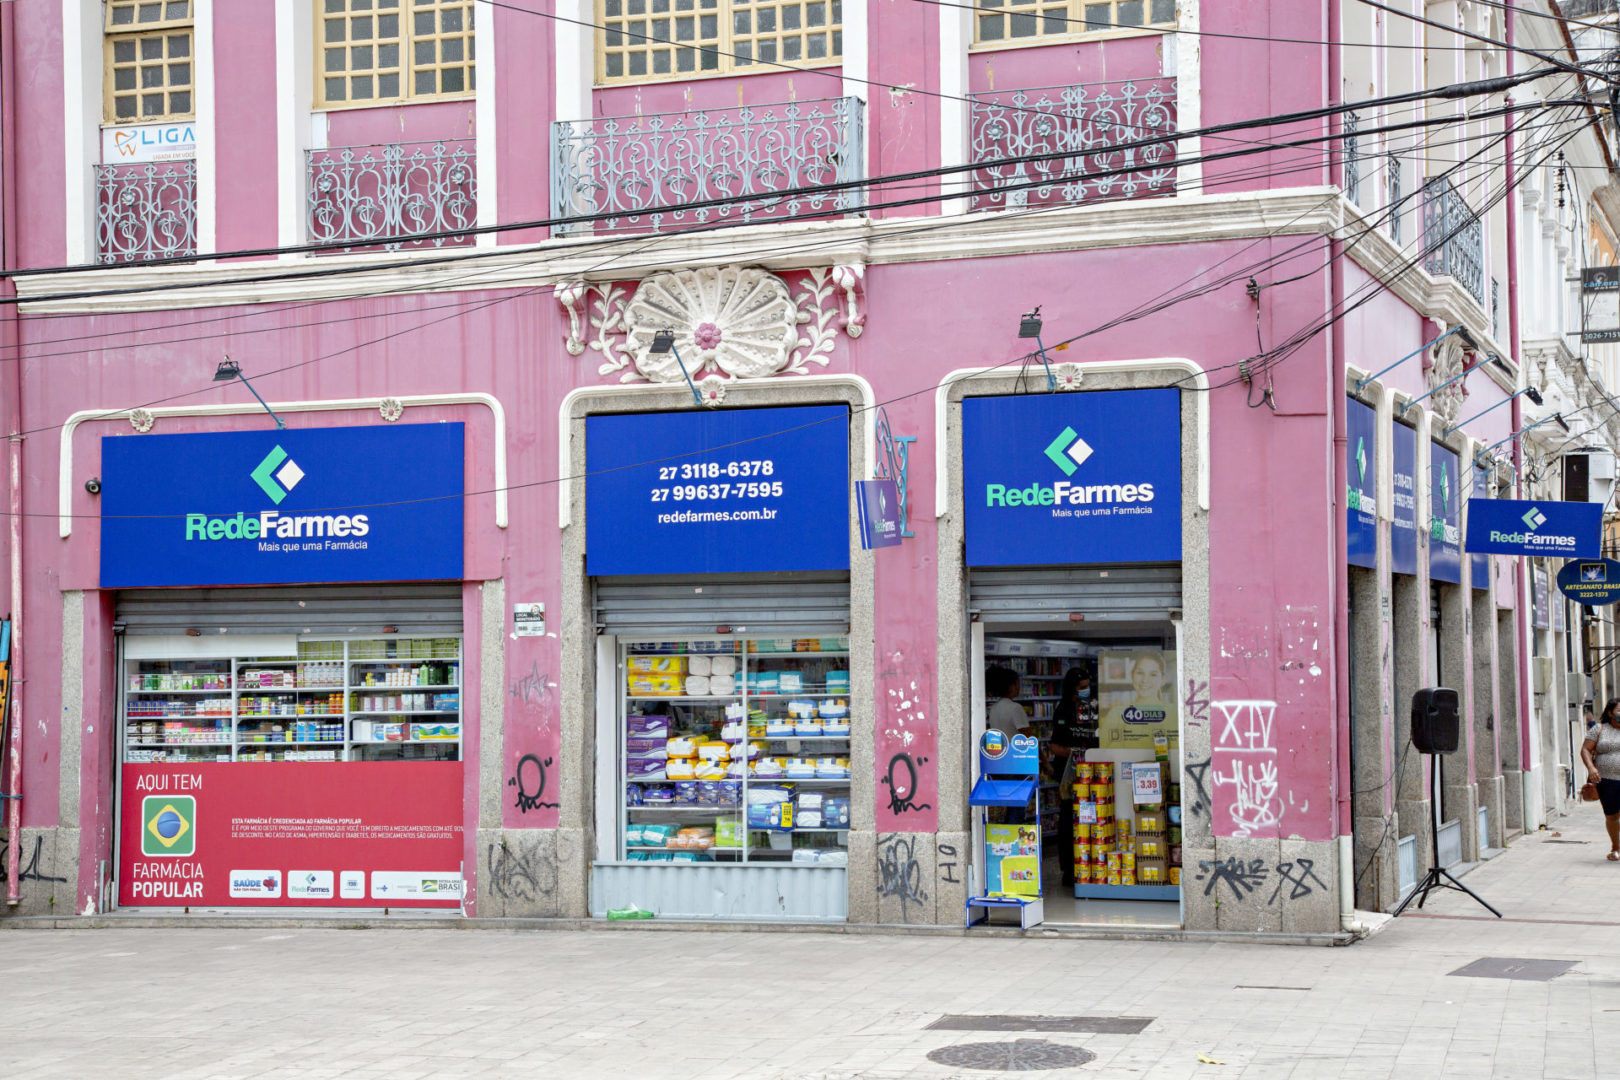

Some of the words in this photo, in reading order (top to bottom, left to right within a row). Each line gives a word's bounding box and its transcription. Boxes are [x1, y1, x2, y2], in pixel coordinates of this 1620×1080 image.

[142, 127, 195, 145] LIGA
[660, 467, 677, 480] 27
[681, 460, 774, 479] 3118-6378
[651, 489, 669, 502] 27
[673, 481, 783, 501] 99637-7595
[986, 481, 1155, 507] RedeFarmes
[658, 507, 777, 524] redefarmes.com.br
[1052, 508, 1072, 517] Mais
[1074, 508, 1090, 518] que
[1092, 508, 1111, 516] uma
[1113, 506, 1152, 515] Farmácia
[186, 511, 369, 540] RedeFarmes
[258, 542, 280, 552] Mais
[282, 542, 300, 553] que
[302, 542, 322, 551] uma
[325, 540, 368, 550] Farmácia
[1490, 530, 1576, 546] RedeFarmes
[1126, 710, 1143, 720] 40
[1144, 710, 1163, 718] DIAS
[136, 774, 168, 792] AQUI
[173, 774, 202, 790] TEM
[1140, 780, 1158, 789] 3,39
[133, 860, 204, 879] FARMÁCIA
[132, 882, 203, 898] POPULAR
[233, 878, 261, 887] SAÚDE
